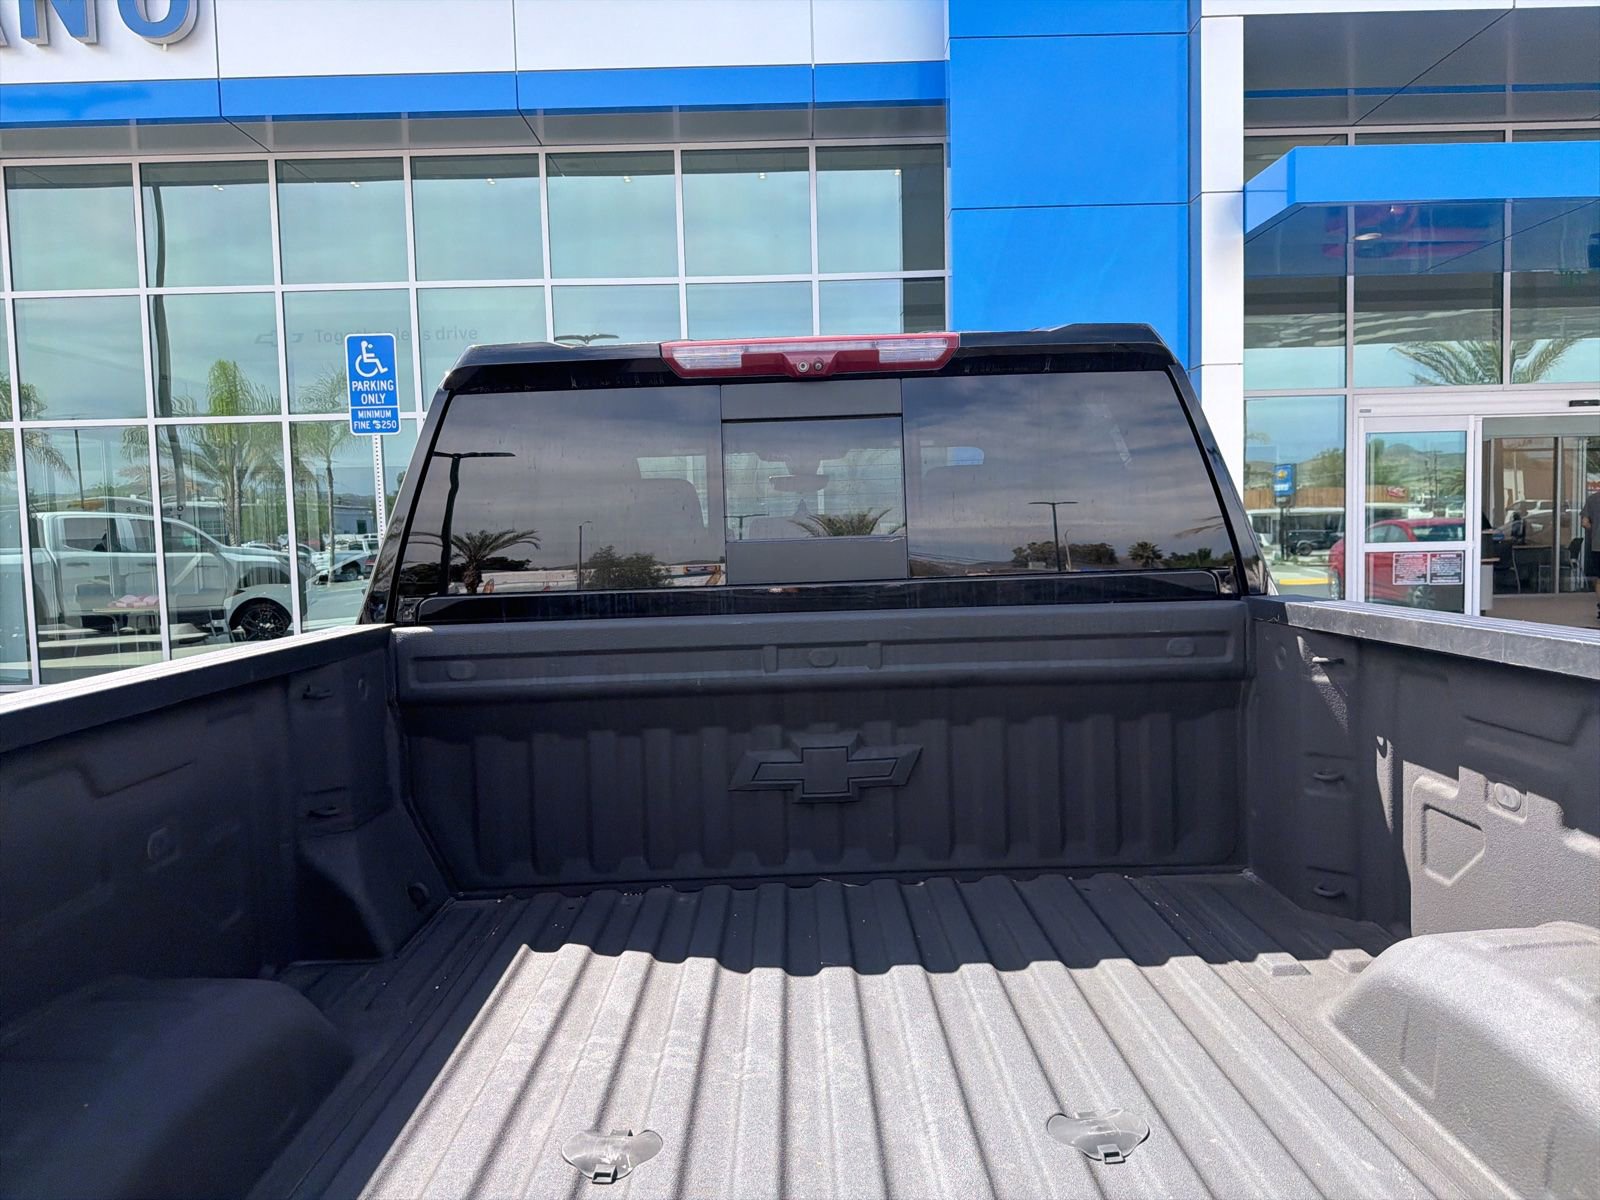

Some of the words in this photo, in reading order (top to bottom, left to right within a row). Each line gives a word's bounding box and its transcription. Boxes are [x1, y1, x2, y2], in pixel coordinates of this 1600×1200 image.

[435, 325, 479, 341] drive
[351, 379, 394, 392] PARKING
[360, 393, 386, 405] ONLY
[357, 409, 392, 419] MINIMUM
[353, 420, 371, 430] FINE
